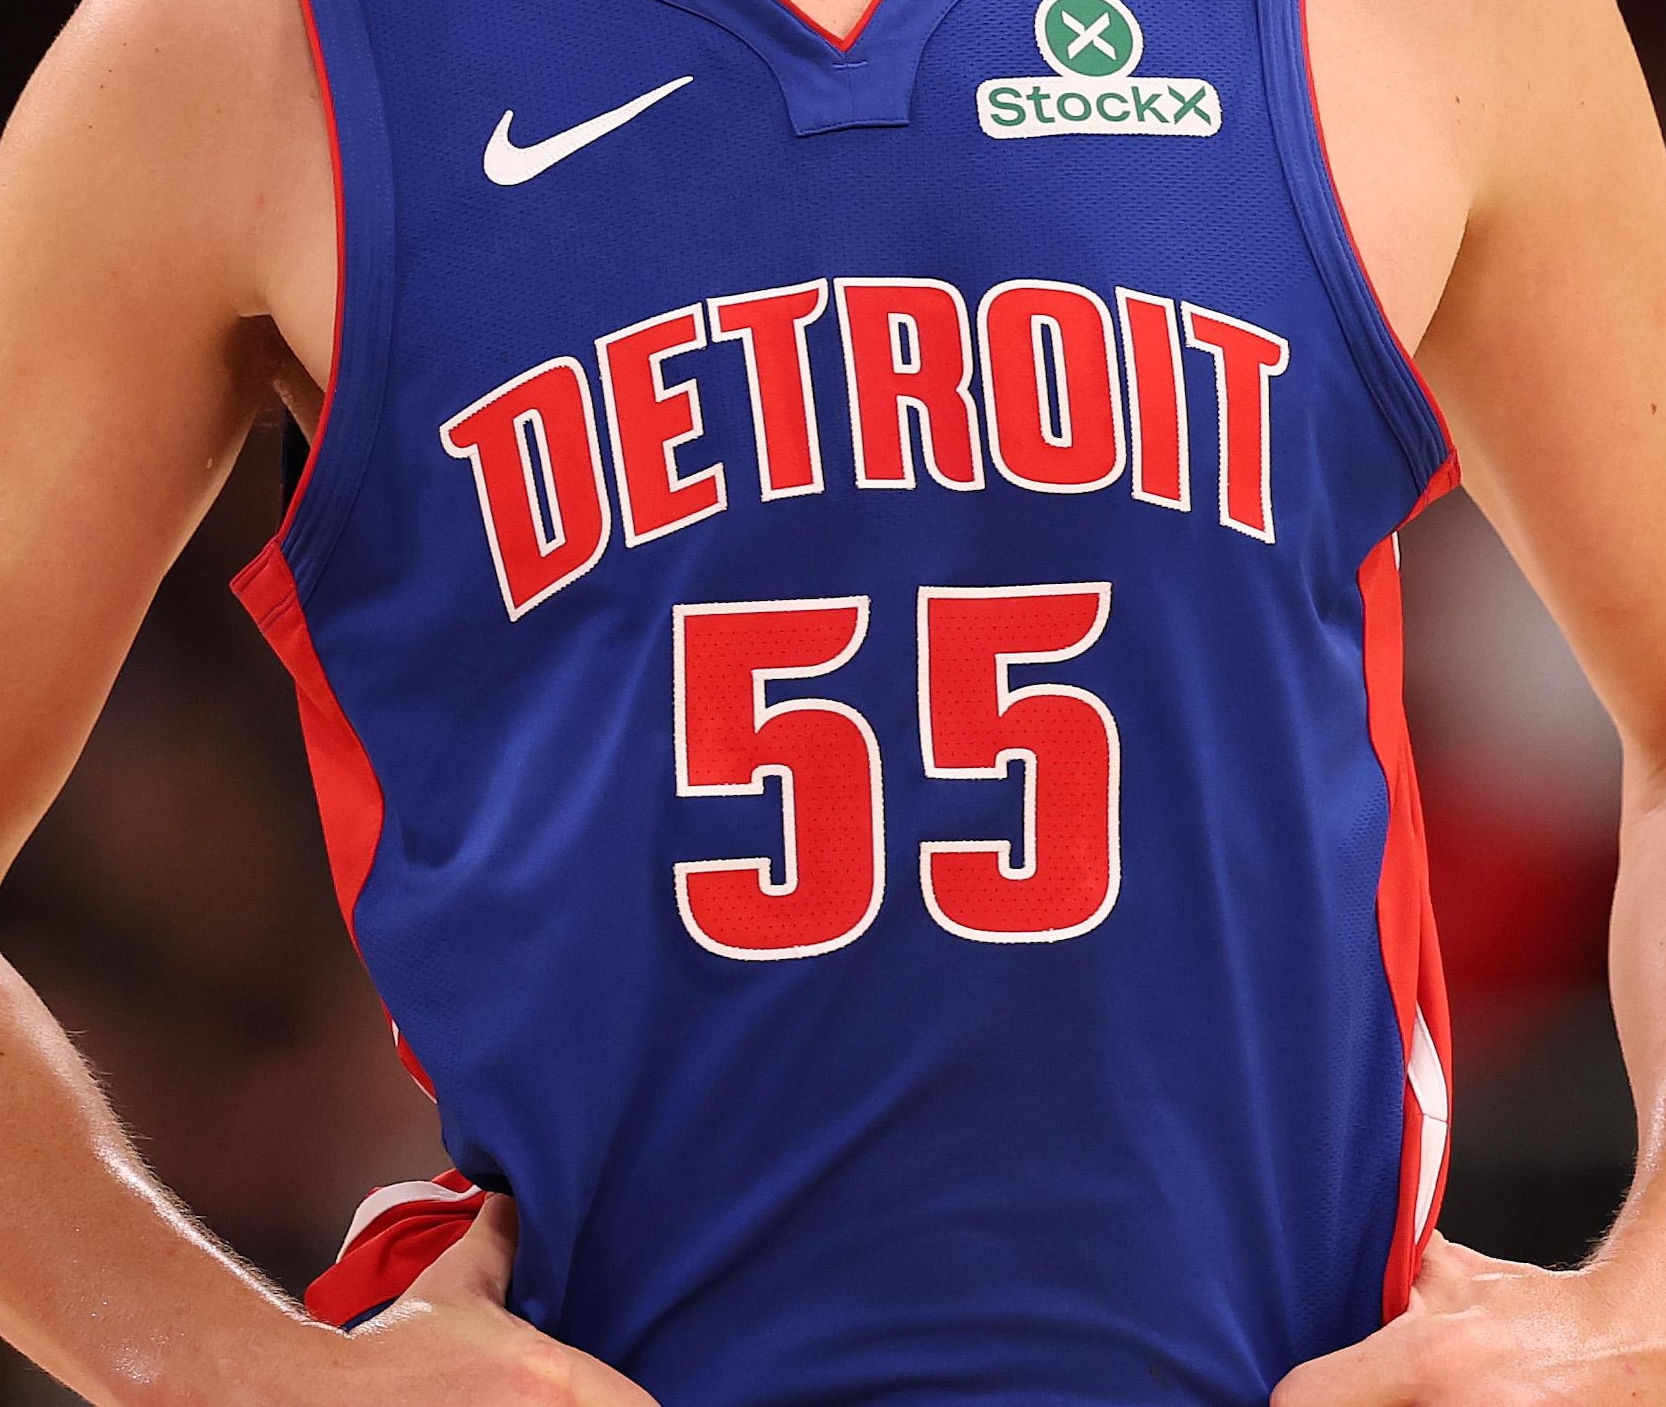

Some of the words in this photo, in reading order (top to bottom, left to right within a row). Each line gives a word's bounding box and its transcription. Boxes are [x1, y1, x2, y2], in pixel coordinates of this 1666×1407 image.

[988, 85, 1212, 127] StockX
[440, 276, 1290, 622] DETROIT
[672, 581, 1121, 961] 55
